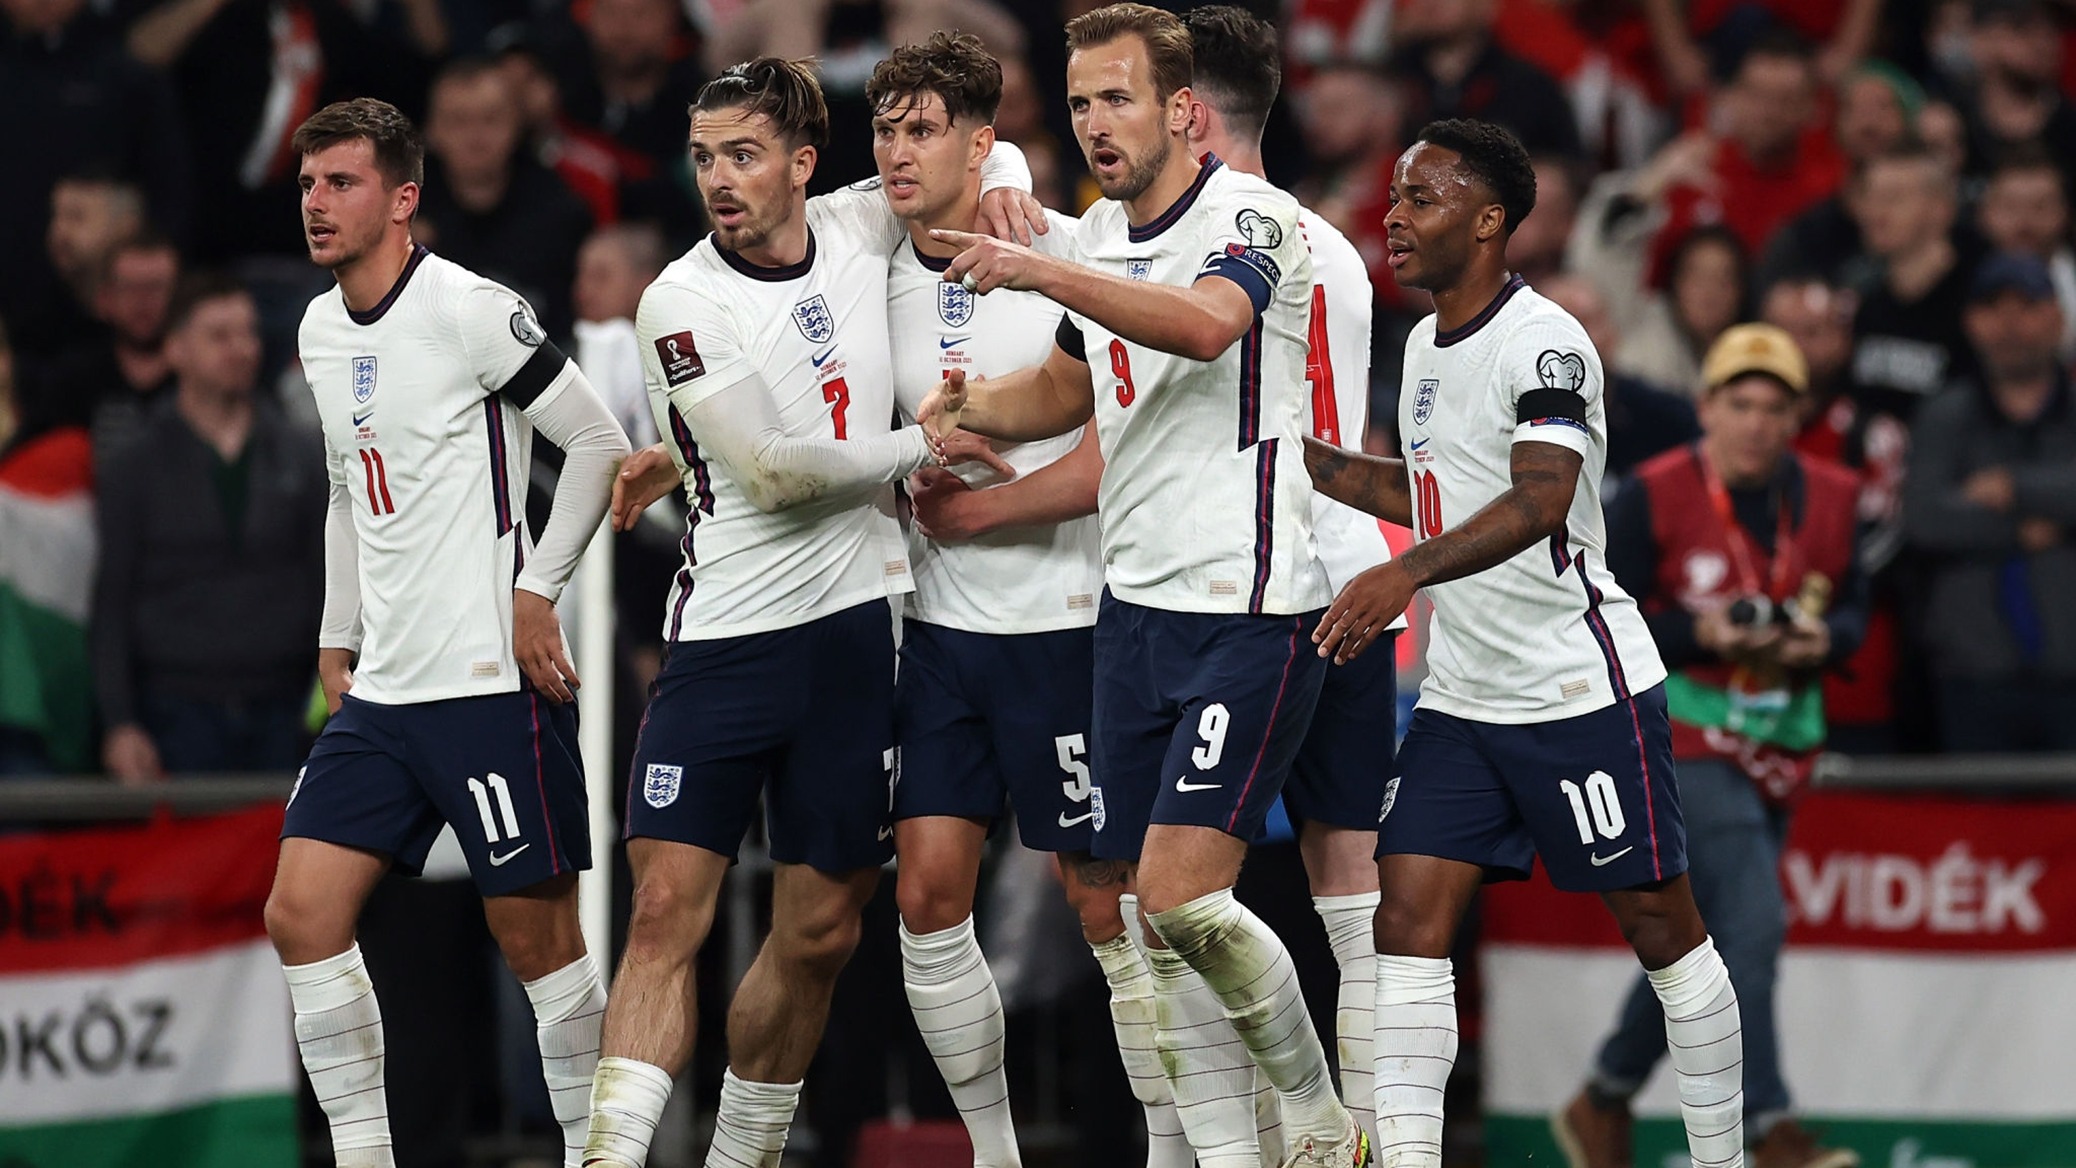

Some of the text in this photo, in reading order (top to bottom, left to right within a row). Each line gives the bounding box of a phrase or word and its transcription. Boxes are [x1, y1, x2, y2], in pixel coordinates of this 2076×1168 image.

[1244, 248, 1280, 282] RESPECT
[1109, 338, 1135, 408] 9
[822, 376, 850, 441] 7
[359, 447, 395, 516] 11
[1413, 469, 1443, 540] 10
[1055, 733, 1092, 802] 5
[1191, 702, 1231, 771] 9
[467, 772, 521, 843] 11
[1560, 770, 1626, 845] 10
[0, 858, 122, 940] ÉK
[1786, 841, 2046, 934] VIDÉK
